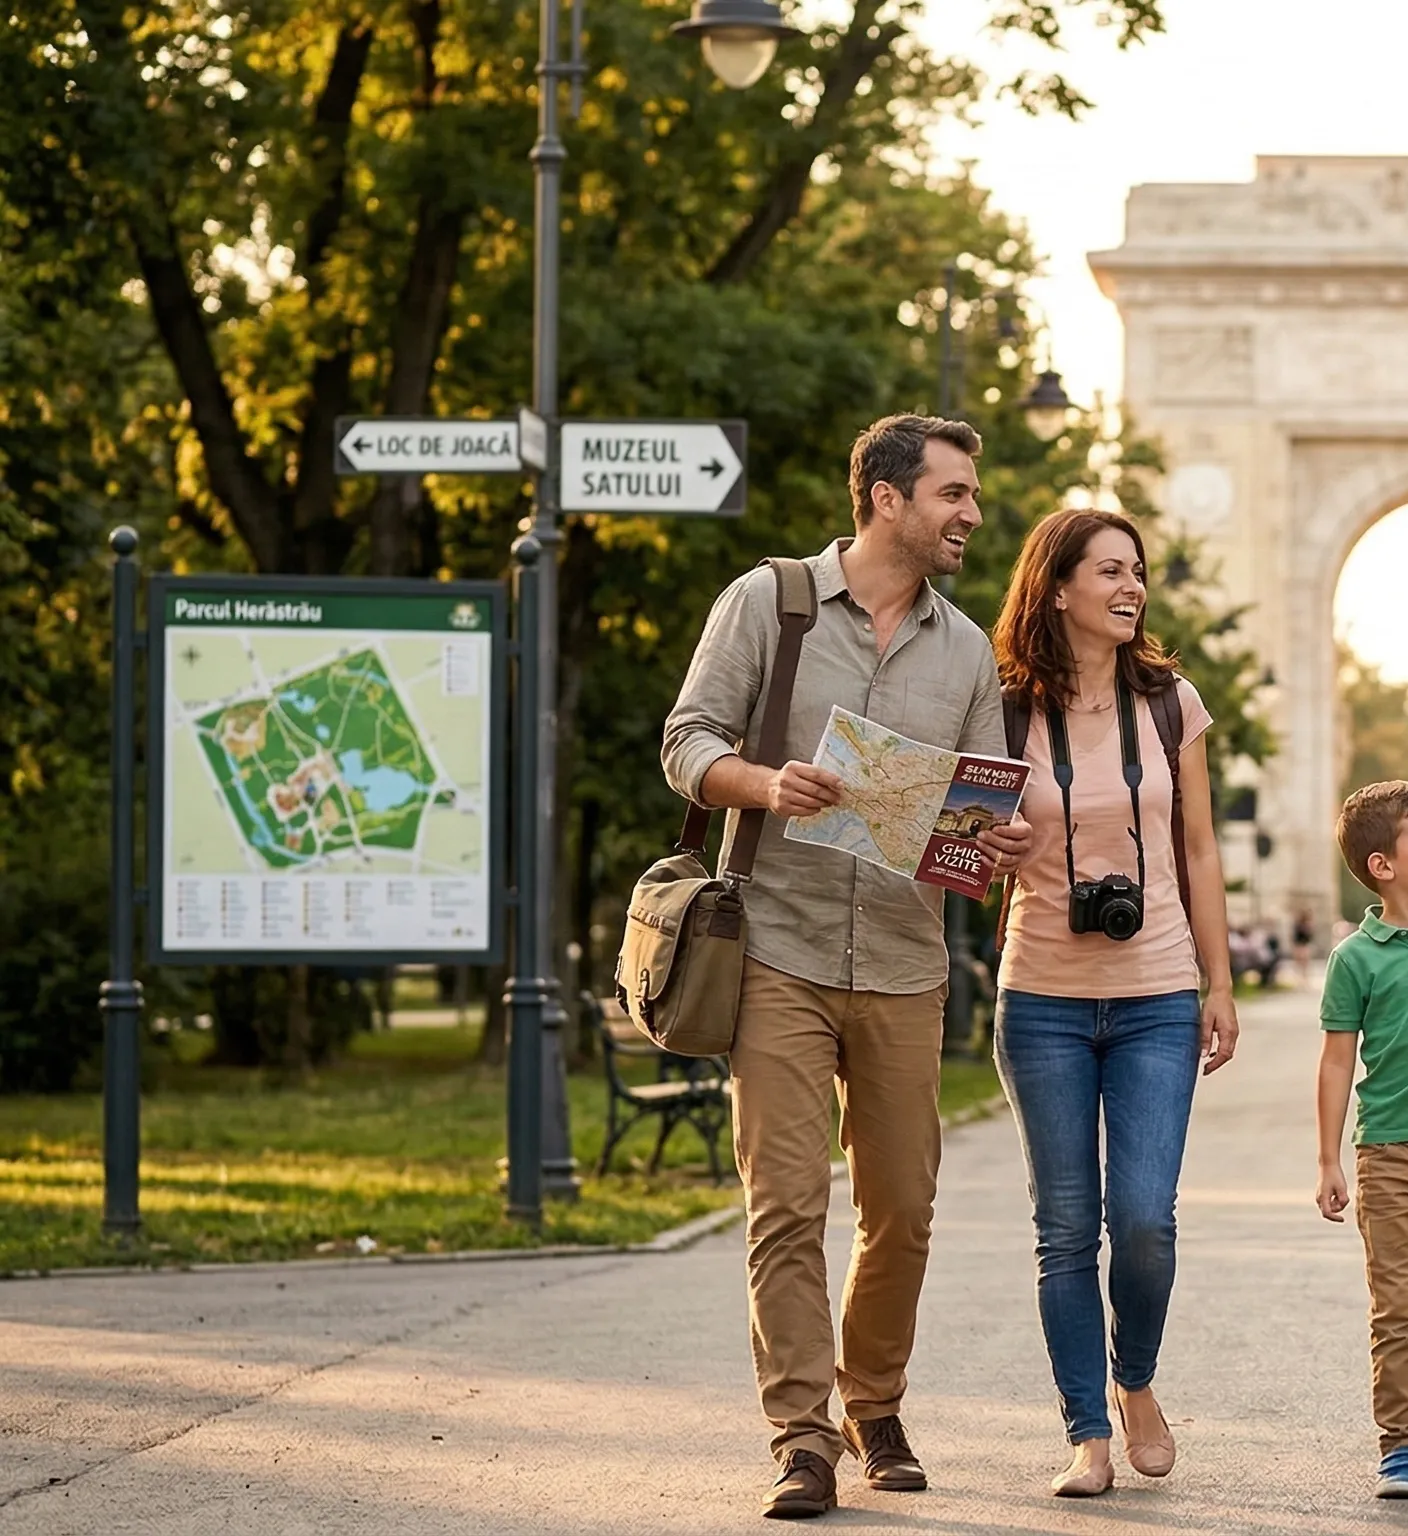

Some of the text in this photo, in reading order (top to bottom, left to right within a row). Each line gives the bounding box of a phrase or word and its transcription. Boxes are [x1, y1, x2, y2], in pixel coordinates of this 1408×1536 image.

[377, 431, 512, 456] LOC DE JOACĂ
[582, 438, 681, 463] MUZEUL
[582, 472, 682, 497] SATULUI
[175, 598, 323, 622] Parcul Herăstrău
[934, 852, 981, 874] VIZITE
